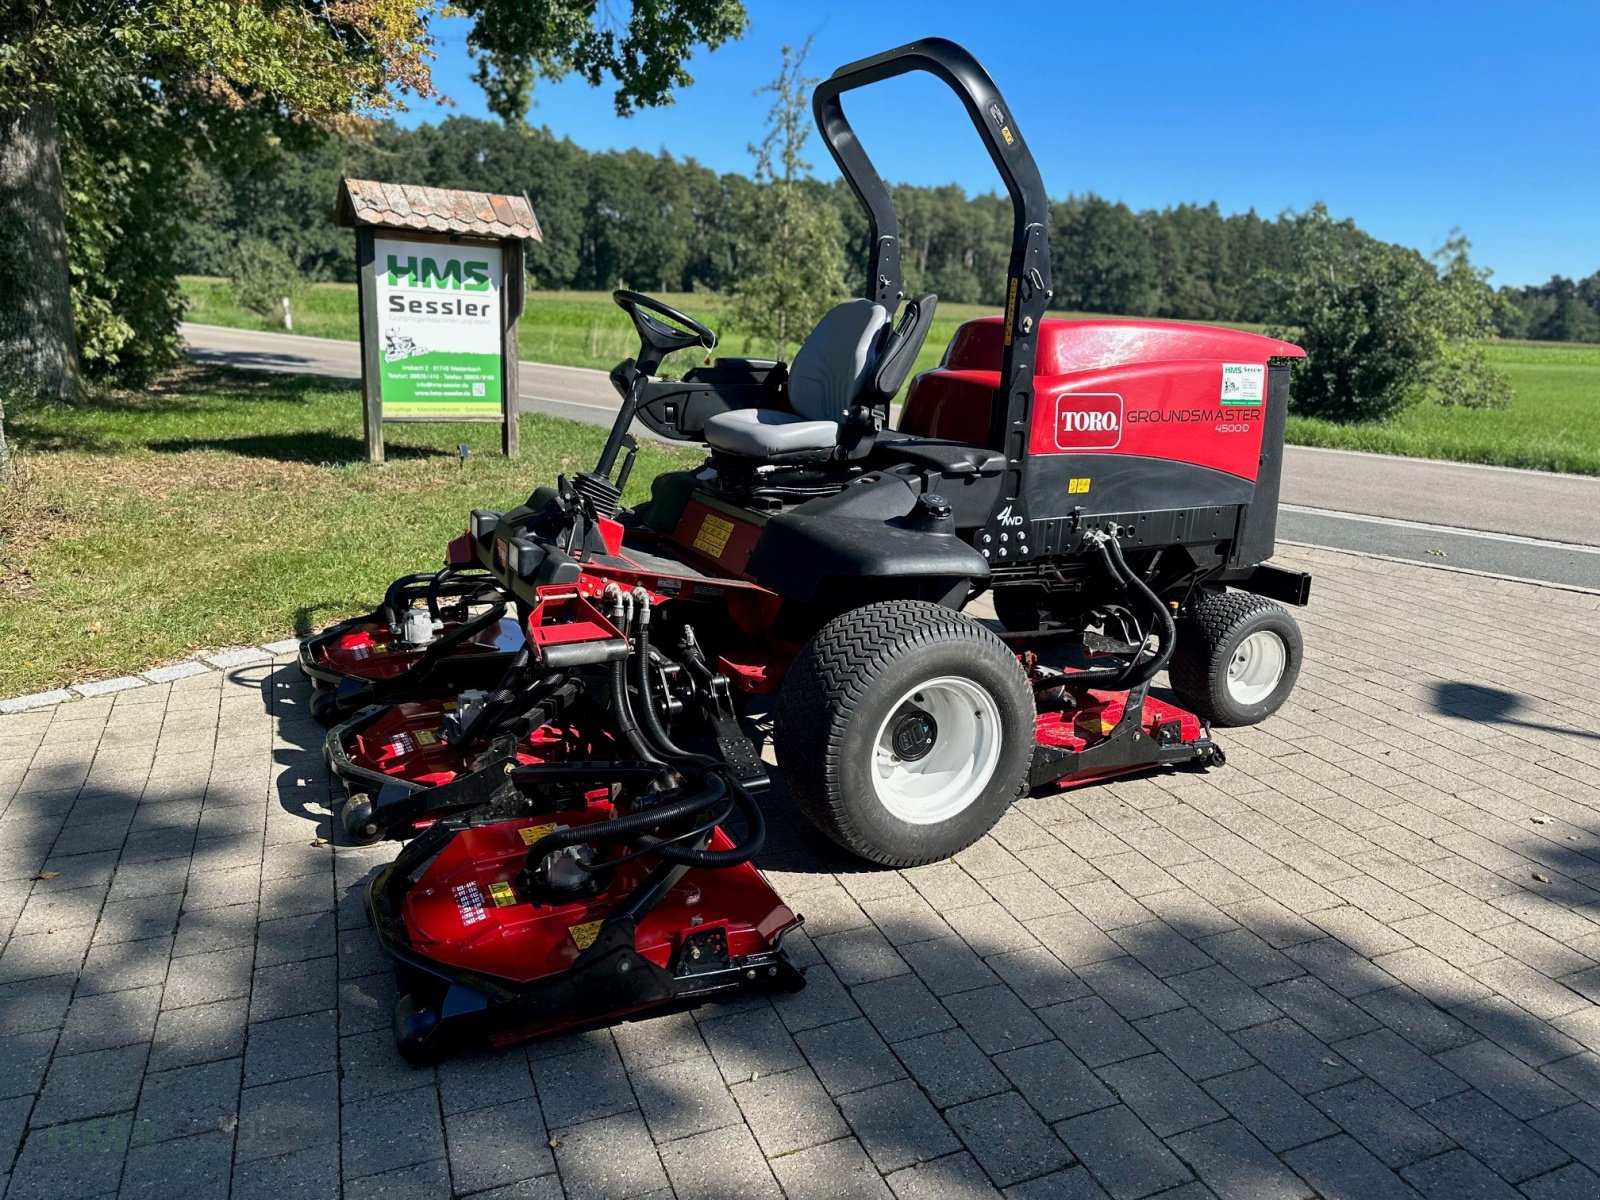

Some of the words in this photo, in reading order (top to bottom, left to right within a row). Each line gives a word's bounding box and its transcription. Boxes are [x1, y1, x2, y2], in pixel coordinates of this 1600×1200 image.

[387, 254, 490, 292] HMS
[389, 295, 490, 317] Sessler
[1224, 366, 1242, 374] HMS
[1126, 409, 1261, 423] GROUNDSMASTER
[996, 504, 1024, 526] 4WD
